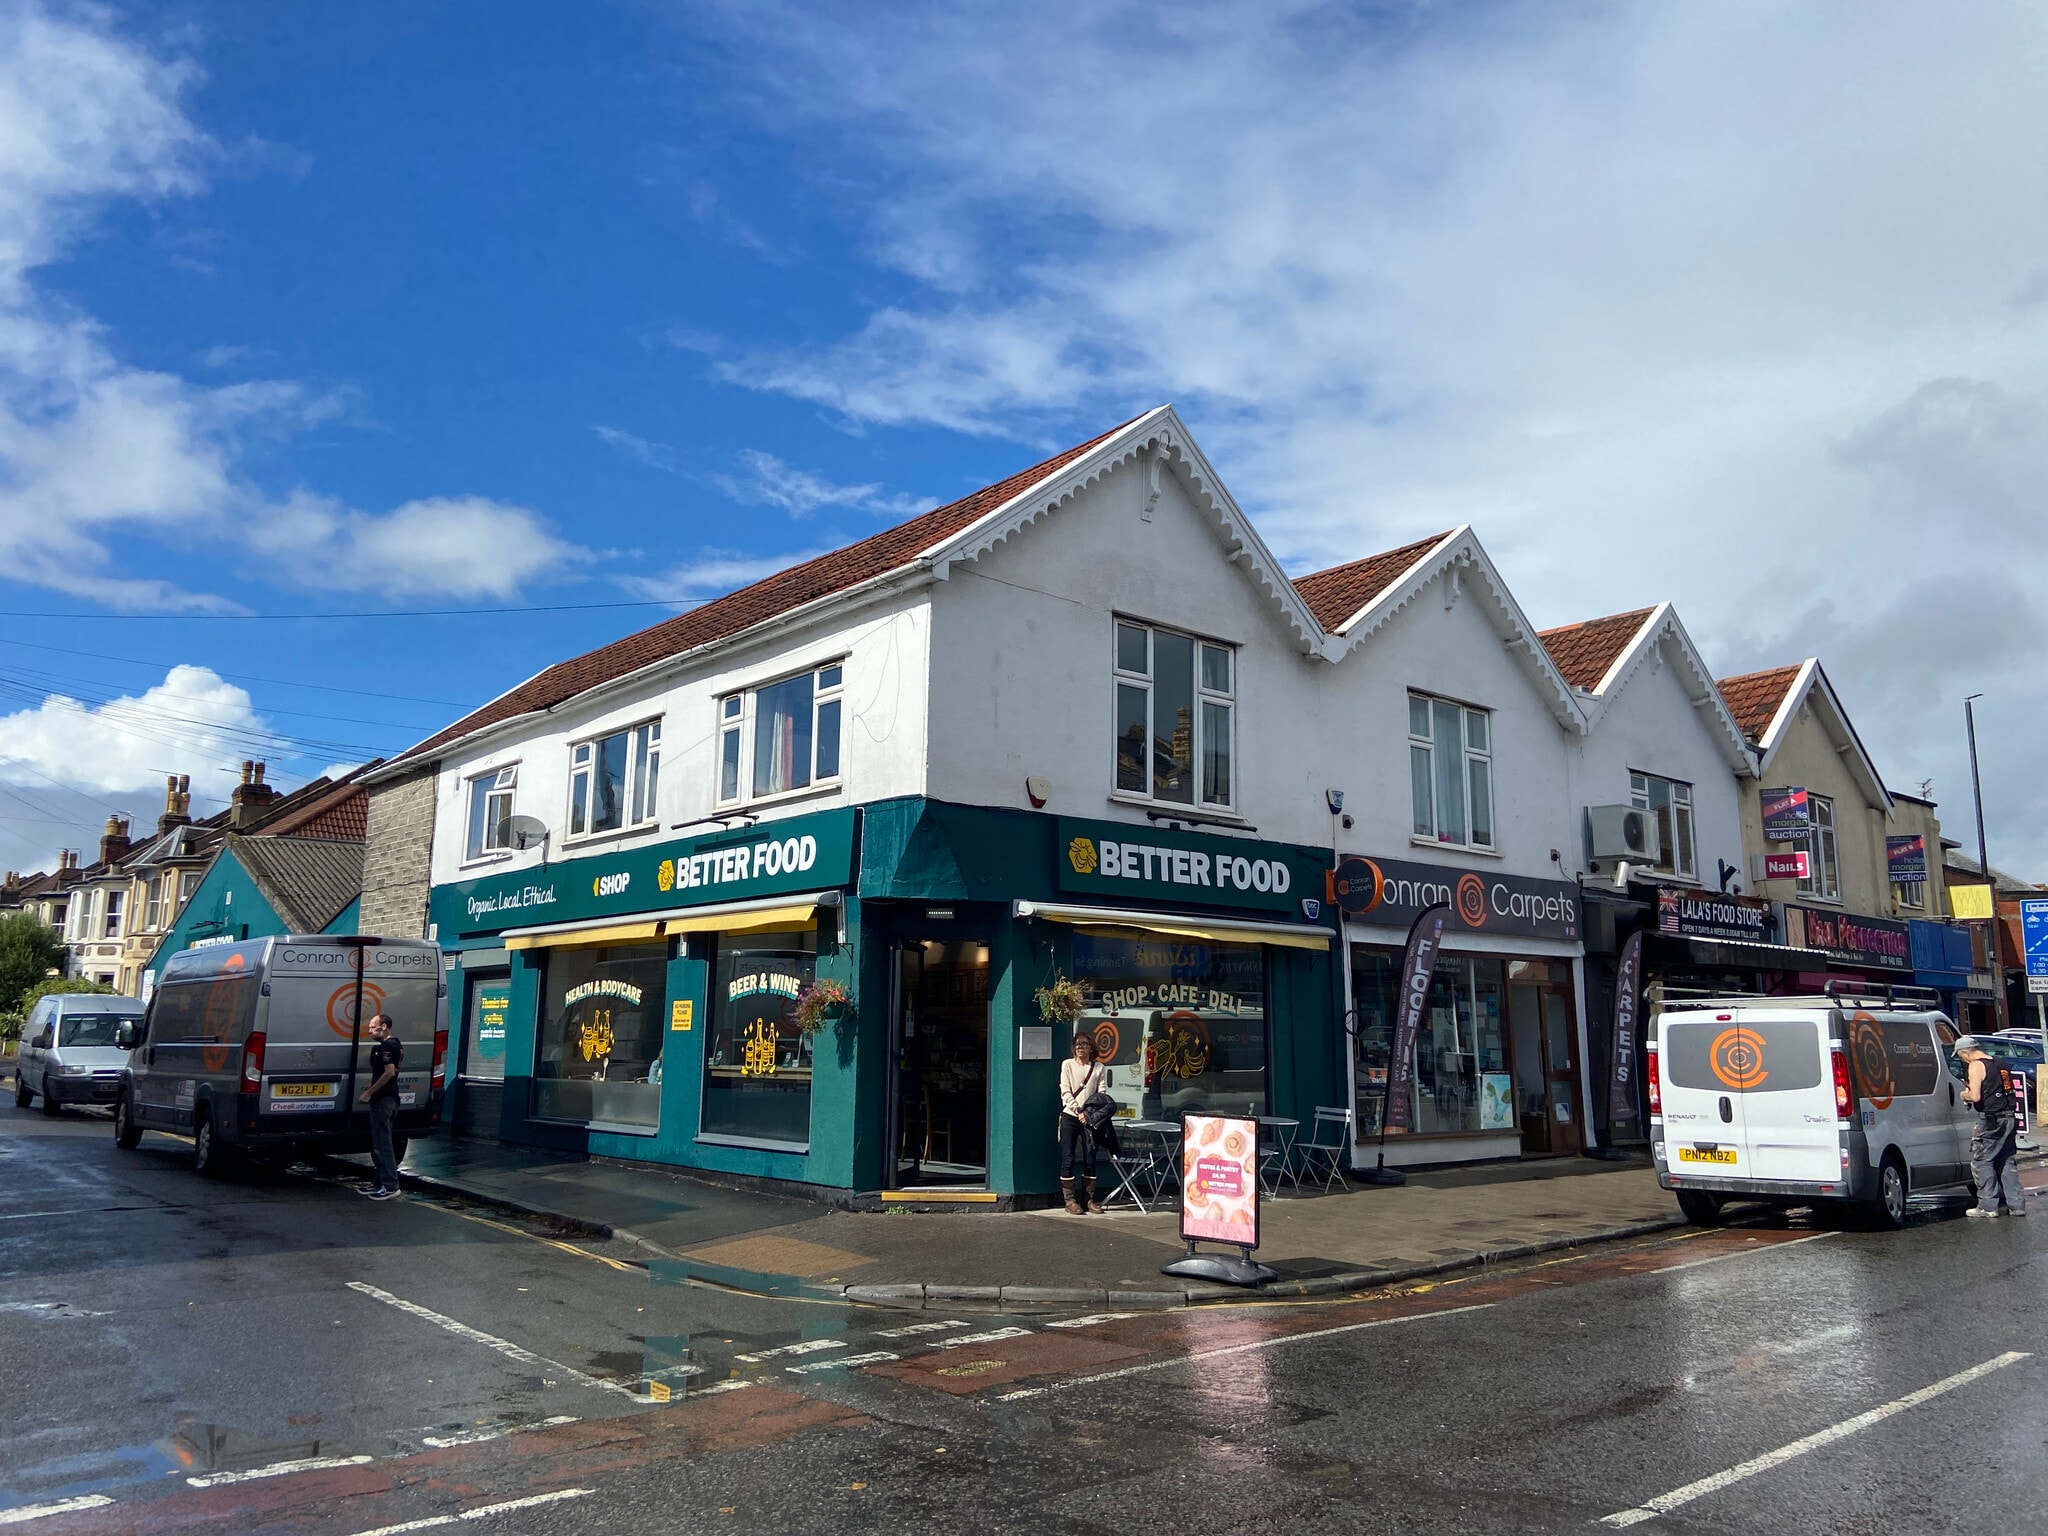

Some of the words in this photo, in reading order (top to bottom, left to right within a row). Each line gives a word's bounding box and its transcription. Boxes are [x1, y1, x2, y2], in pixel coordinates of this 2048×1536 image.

[1774, 800, 1789, 810] FLAT
[1785, 811, 1807, 819] hollis
[1772, 820, 1807, 828] morgan
[1769, 830, 1809, 839] auction
[676, 846, 750, 890] BETTER
[752, 835, 817, 878] FOOD
[1100, 840, 1211, 886] BETTER
[1216, 854, 1290, 894] FOOD
[600, 872, 630, 896] SHOP
[1350, 876, 1371, 884] Conran
[1890, 874, 1926, 882] auction
[1350, 884, 1373, 892] Carpets
[468, 896, 498, 922] Organic.
[498, 890, 522, 910] Local.
[522, 884, 556, 906] Ethical.
[1383, 879, 1452, 910] onran
[1491, 884, 1575, 926] Carpets
[1681, 899, 1710, 921] LALA'S
[1712, 903, 1735, 923] FOOD
[1682, 924, 1694, 932] OPEN
[1698, 926, 1710, 934] DAYS
[1714, 928, 1726, 936] WEEK
[282, 950, 344, 964] Conran
[376, 951, 432, 967] Carpets
[566, 982, 594, 1004] HEALTH
[594, 980, 600, 994] &
[601, 980, 642, 1004] BODYCARE
[730, 974, 757, 998] BEER
[759, 972, 767, 988] &
[770, 973, 800, 997] WINE
[1102, 986, 1148, 1012] SHOP
[1158, 984, 1198, 1004] CAFE
[1210, 989, 1242, 1014] DELI
[1617, 960, 1633, 1082] CARPETS
[282, 1083, 304, 1094] WG21
[306, 1083, 325, 1094] LFJ
[1686, 1150, 1708, 1160] PN12
[1711, 1151, 1730, 1161] NBZ
